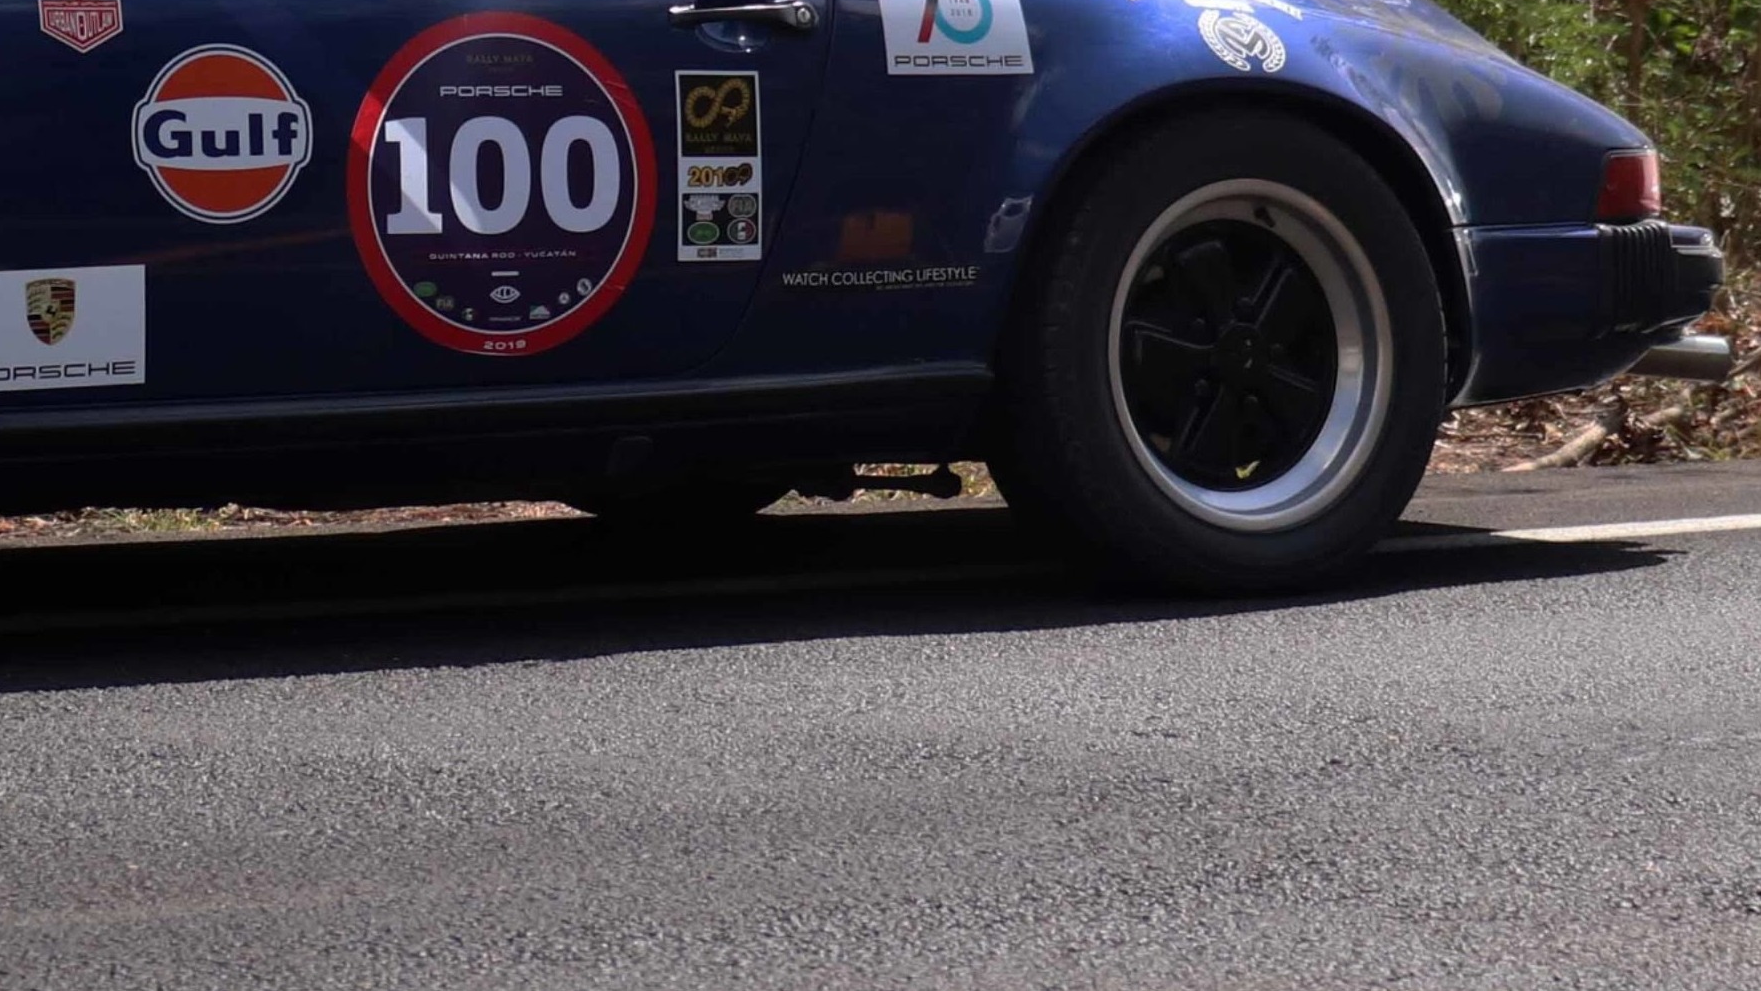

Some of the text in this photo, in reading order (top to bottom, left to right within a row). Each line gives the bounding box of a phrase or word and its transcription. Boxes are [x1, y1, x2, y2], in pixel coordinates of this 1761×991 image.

[894, 55, 1025, 68] PORSCHE
[439, 85, 564, 97] PORSCHE
[142, 109, 299, 159] Gulf
[384, 115, 621, 235] 100
[429, 250, 577, 260] QUINTANA ROO YUCATÁN
[782, 272, 829, 285] WATCH
[831, 270, 913, 285] COLLECTING
[916, 266, 976, 280] LIFESTYLE
[483, 340, 527, 351] 2019
